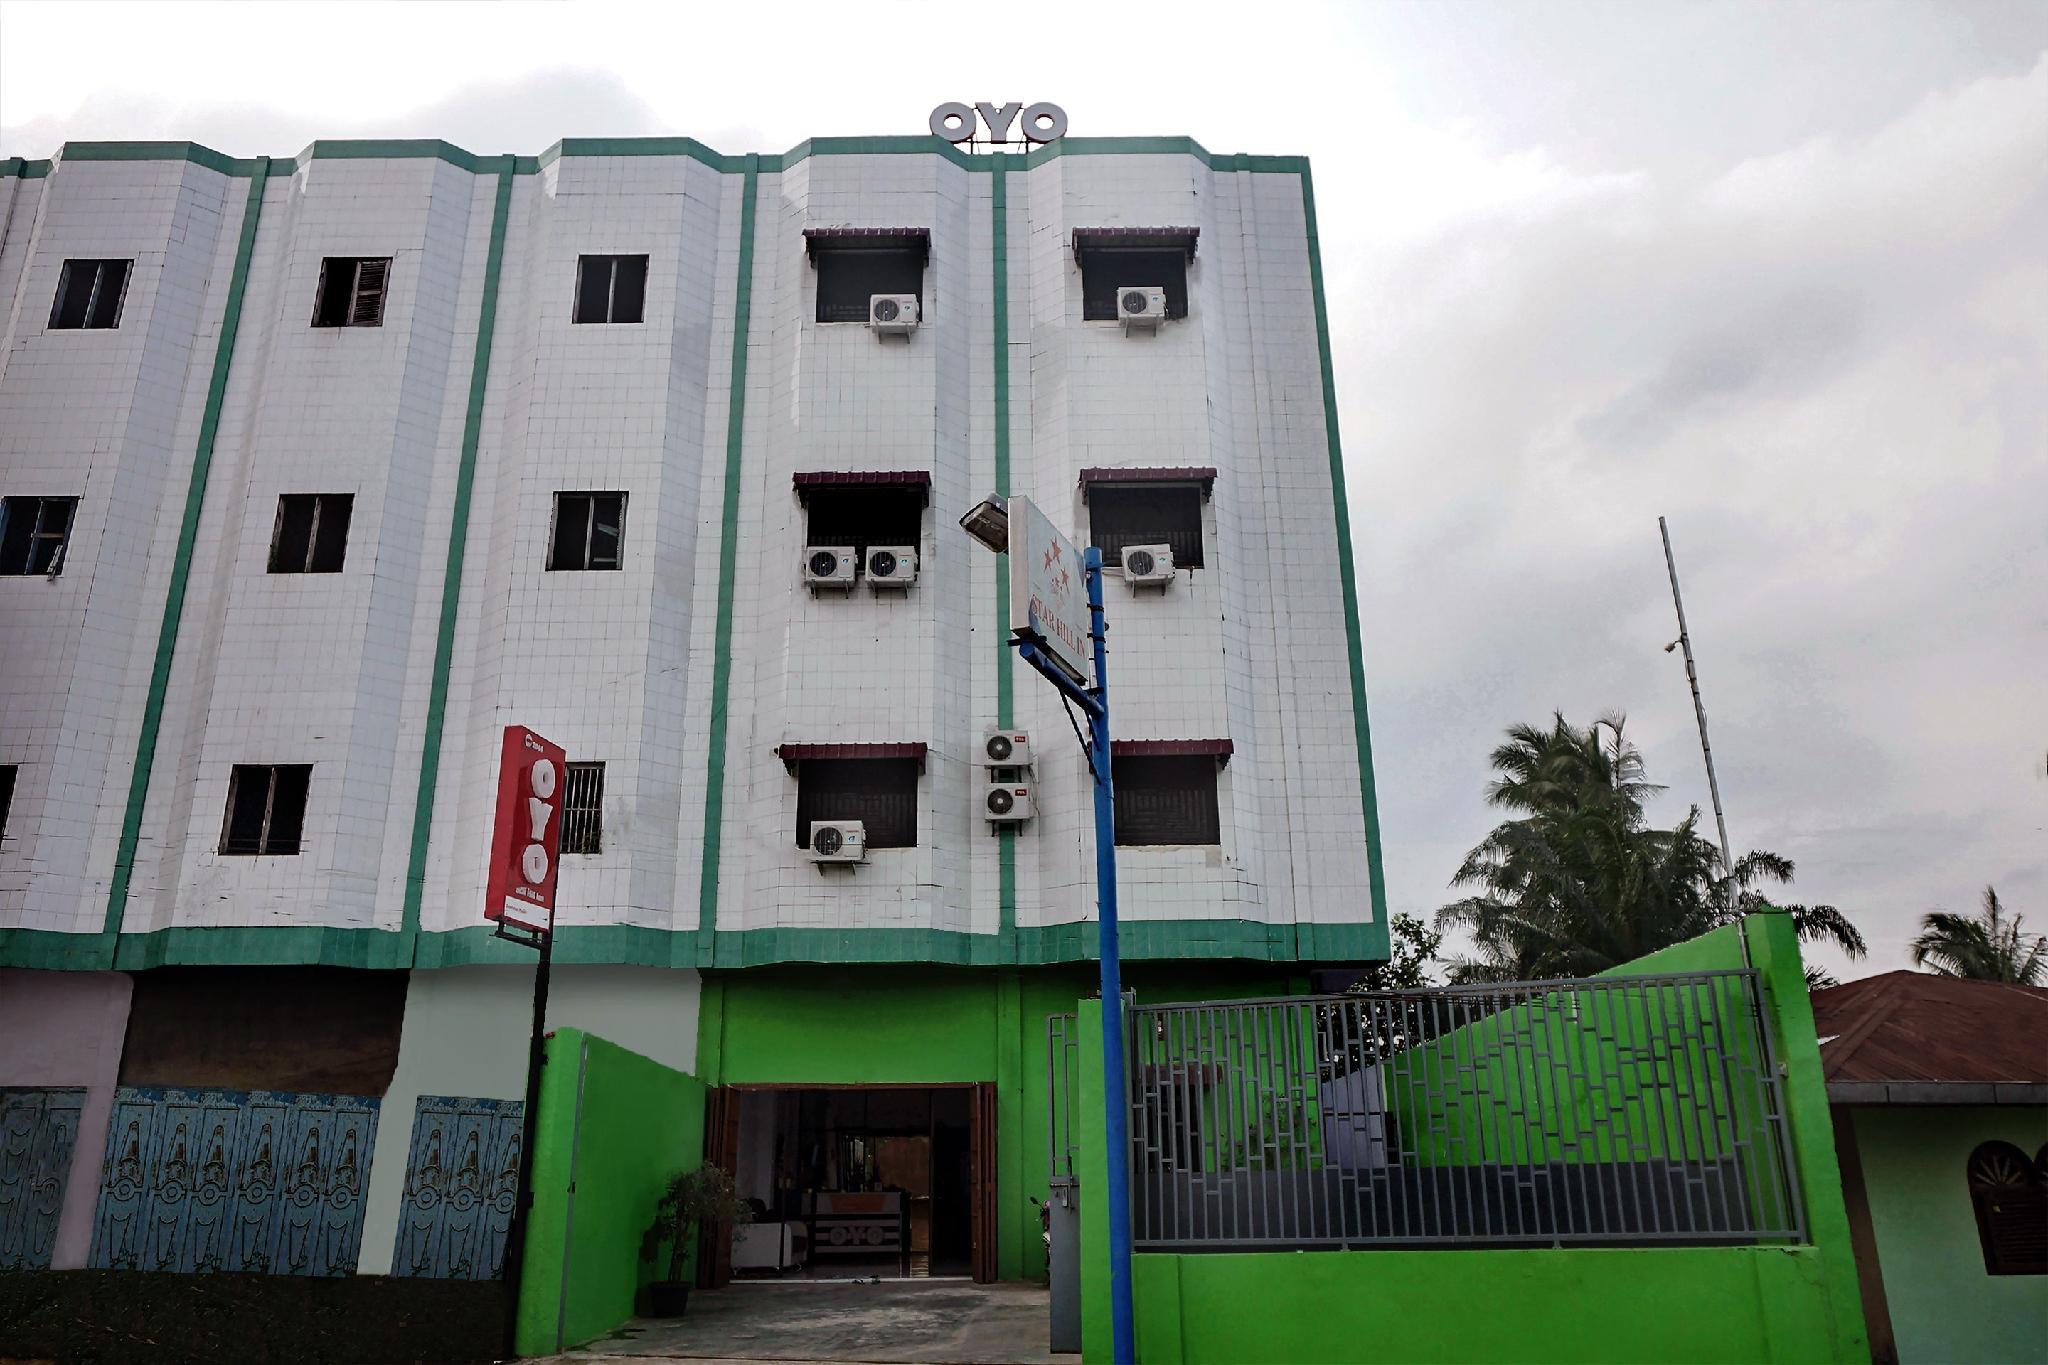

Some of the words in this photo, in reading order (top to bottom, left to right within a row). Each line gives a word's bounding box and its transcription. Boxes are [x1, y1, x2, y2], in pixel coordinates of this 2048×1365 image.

[929, 101, 1068, 145] OYO
[1031, 594, 1055, 632] STAR
[1056, 618, 1076, 652] HILL
[522, 758, 556, 884] OYO
[830, 1226, 882, 1246] OYO
